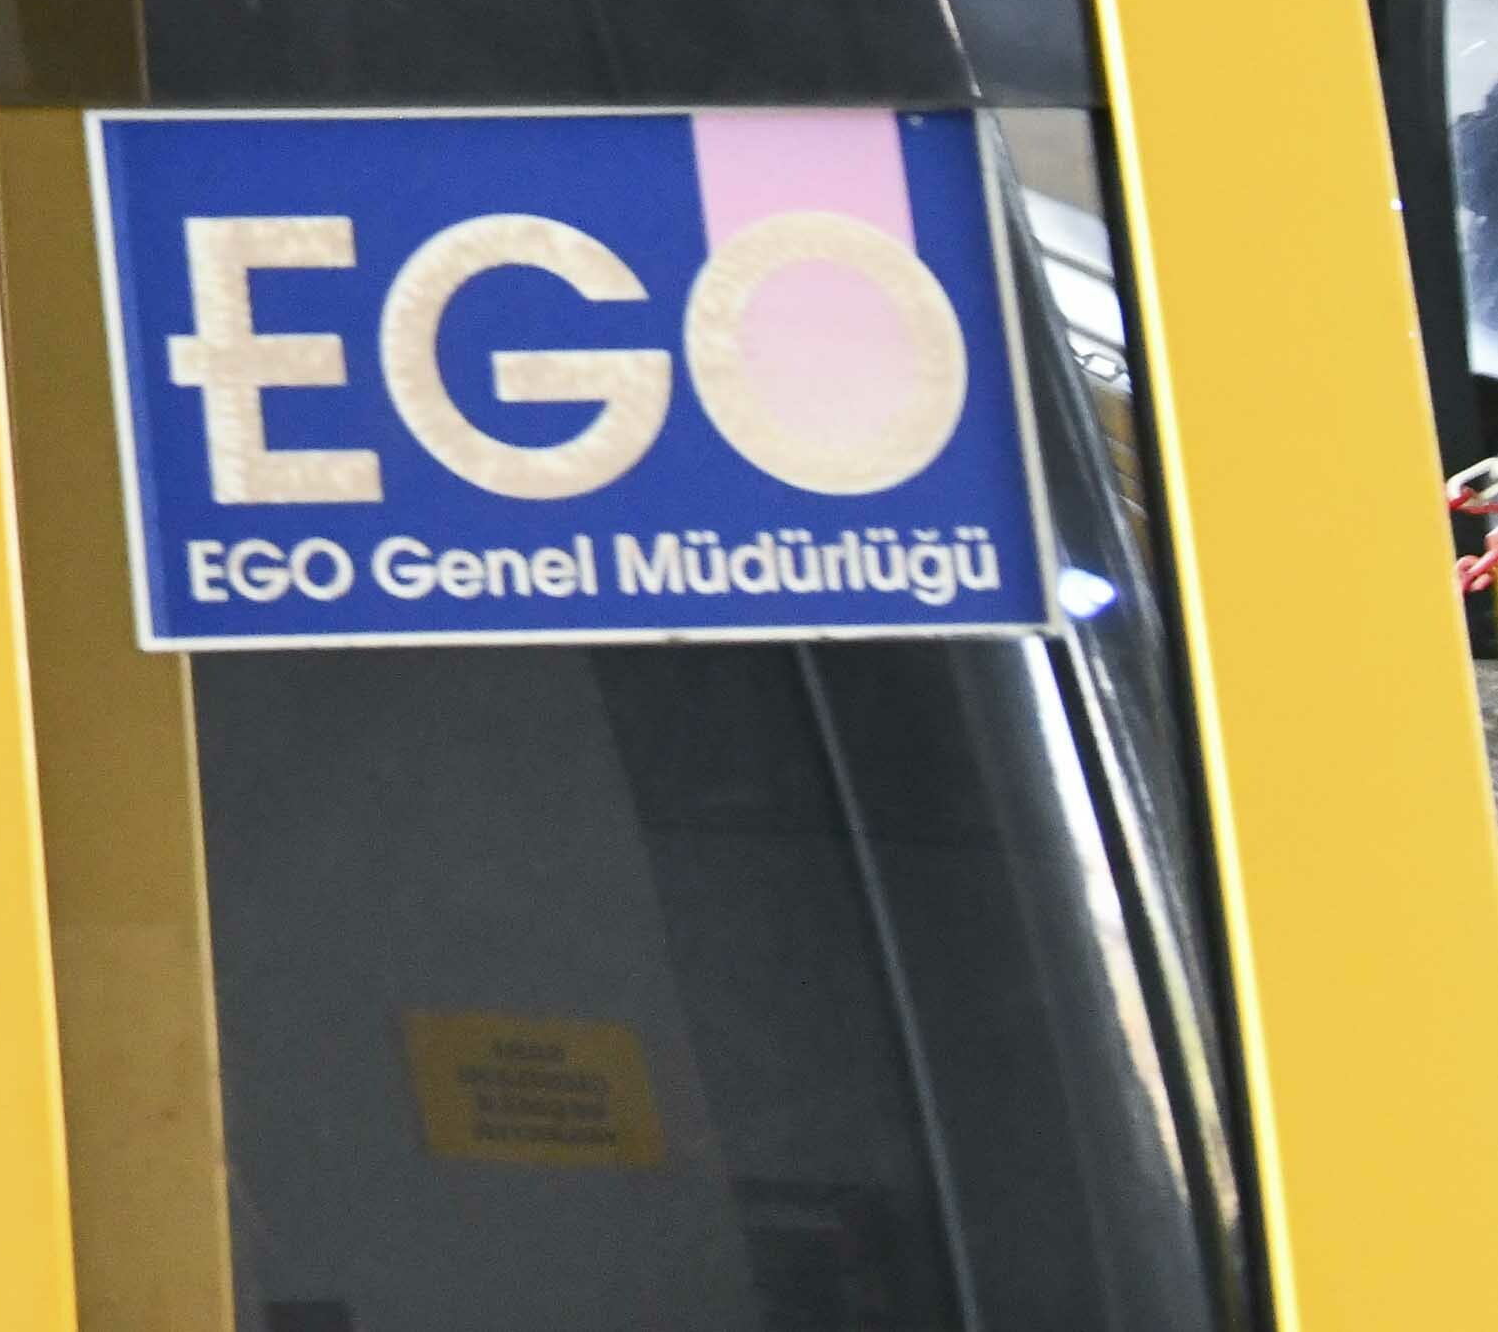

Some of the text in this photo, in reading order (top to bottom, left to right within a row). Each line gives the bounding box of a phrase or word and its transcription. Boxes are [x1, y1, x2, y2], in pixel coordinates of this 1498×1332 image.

[165, 210, 969, 505] EGO
[186, 524, 1001, 606] EGO Genel Müdürlüğü
